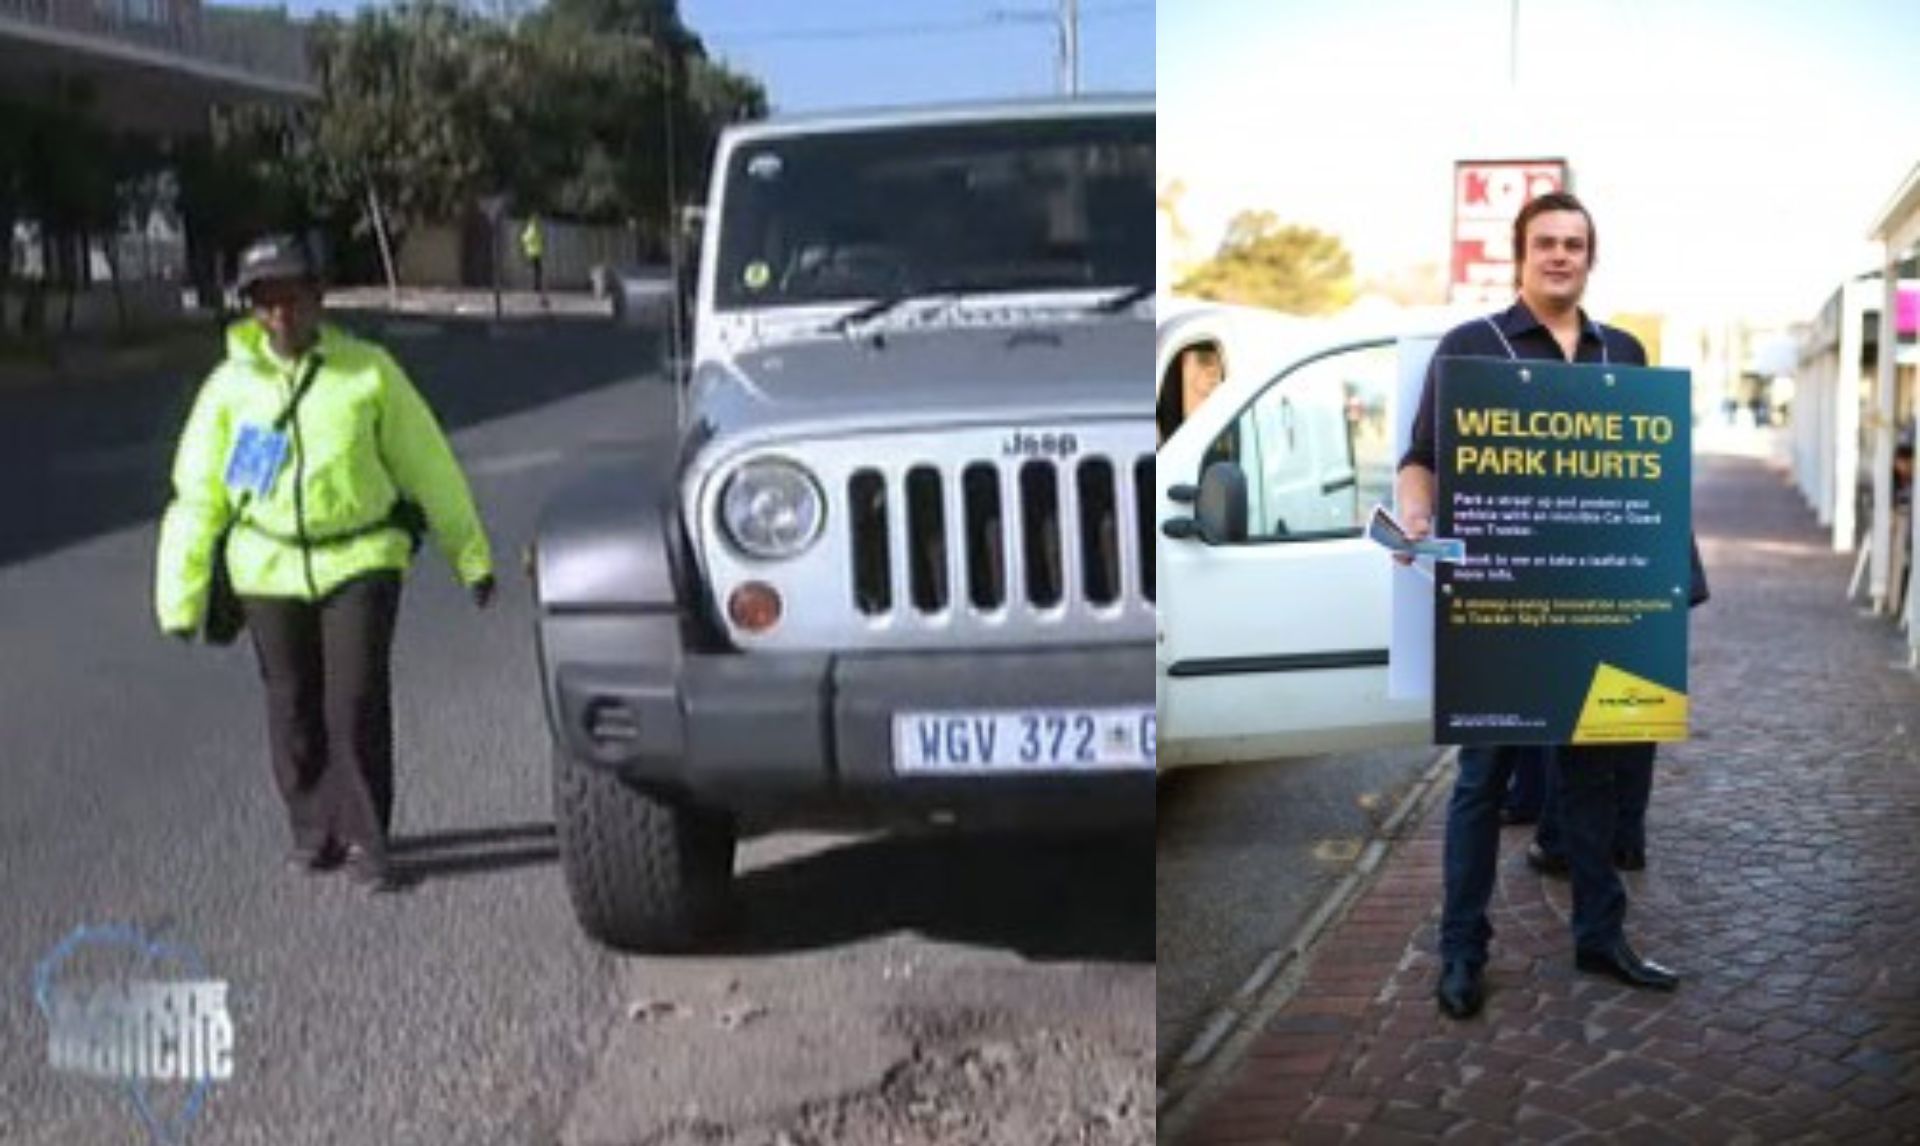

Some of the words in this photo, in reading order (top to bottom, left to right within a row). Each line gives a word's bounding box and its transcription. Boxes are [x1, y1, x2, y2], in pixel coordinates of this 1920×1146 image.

[1455, 407, 1623, 441] WELCOME
[1629, 414, 1673, 443] TO
[1002, 431, 1078, 460] Jeep
[1456, 446, 1547, 476] PARK
[1556, 450, 1662, 480] HURTS
[1453, 492, 1482, 506] Park
[918, 718, 997, 764] WGV
[1019, 713, 1097, 762] 372
